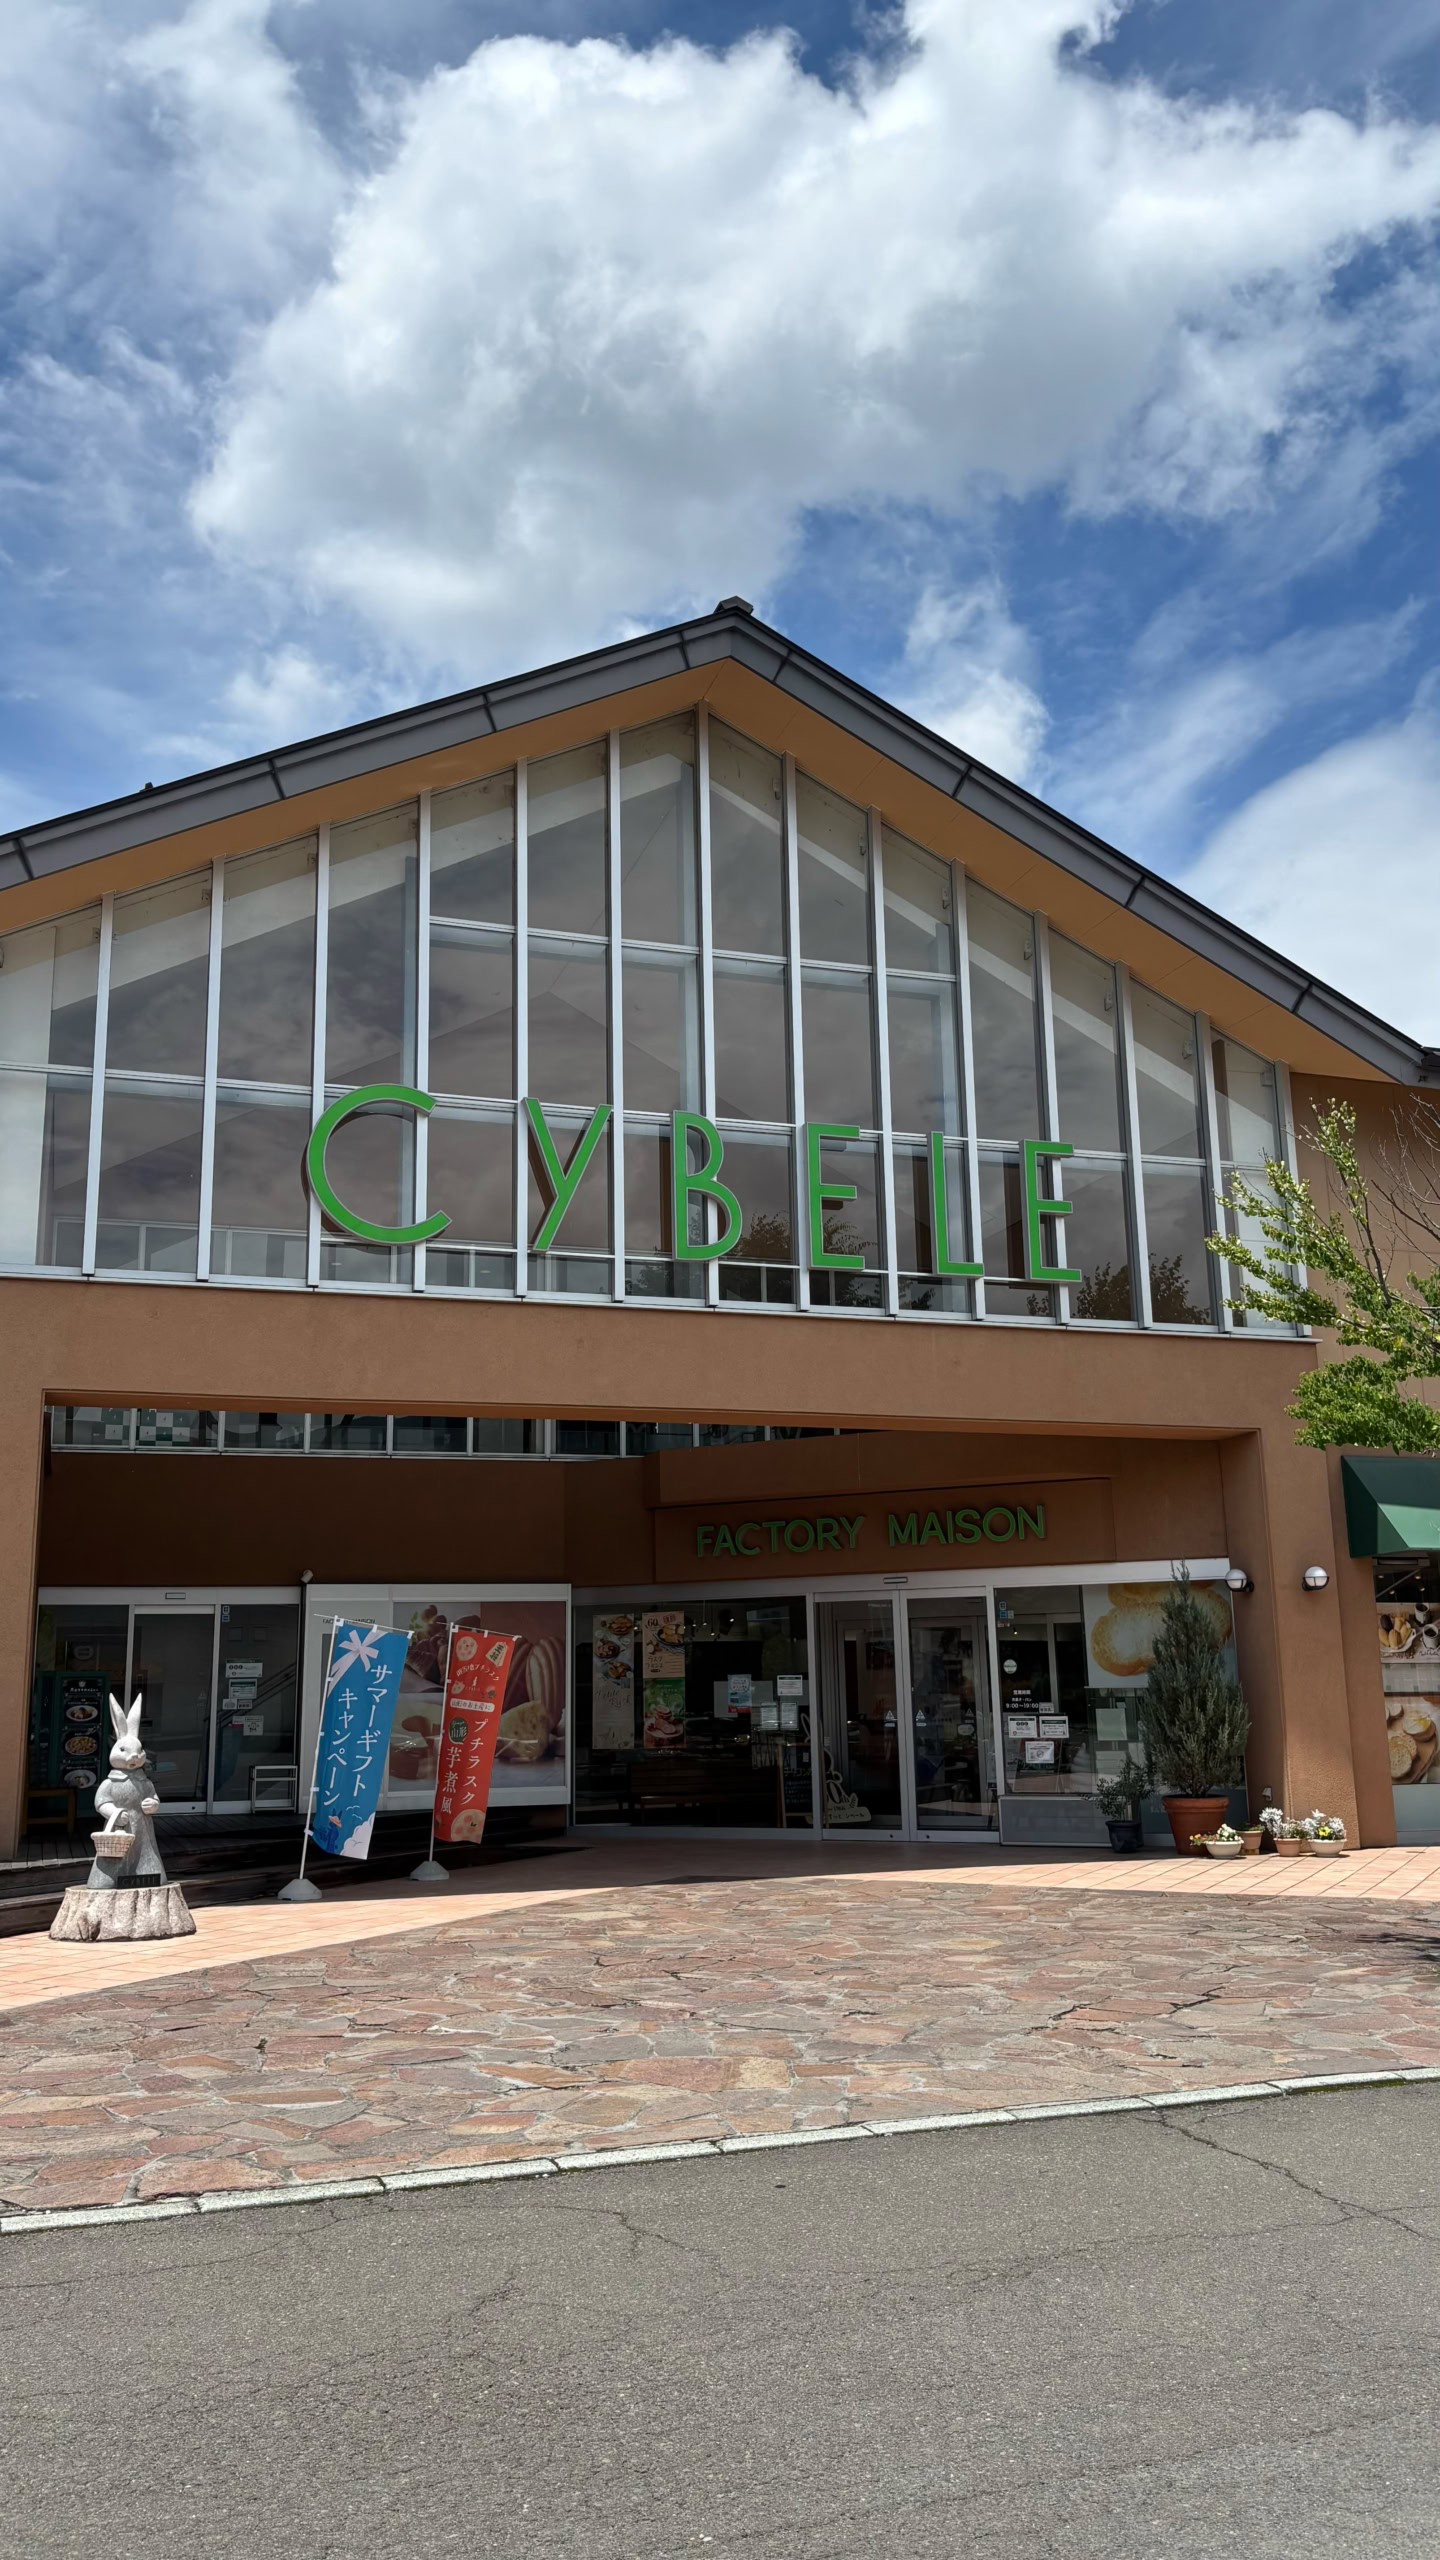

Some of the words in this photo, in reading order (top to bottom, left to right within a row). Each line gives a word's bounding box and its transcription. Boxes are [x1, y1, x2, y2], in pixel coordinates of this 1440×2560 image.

[306, 1083, 1082, 1283] CYBELE
[697, 1516, 865, 1557] FACTORY
[888, 1504, 1046, 1547] MAISON
[323, 1687, 358, 1806] キャンペーン
[352, 1664, 393, 1797] サマーギフト
[451, 1727, 467, 1738] 山形
[460, 1718, 488, 1806] プチラスク
[440, 1746, 461, 1815] 芋煮風
